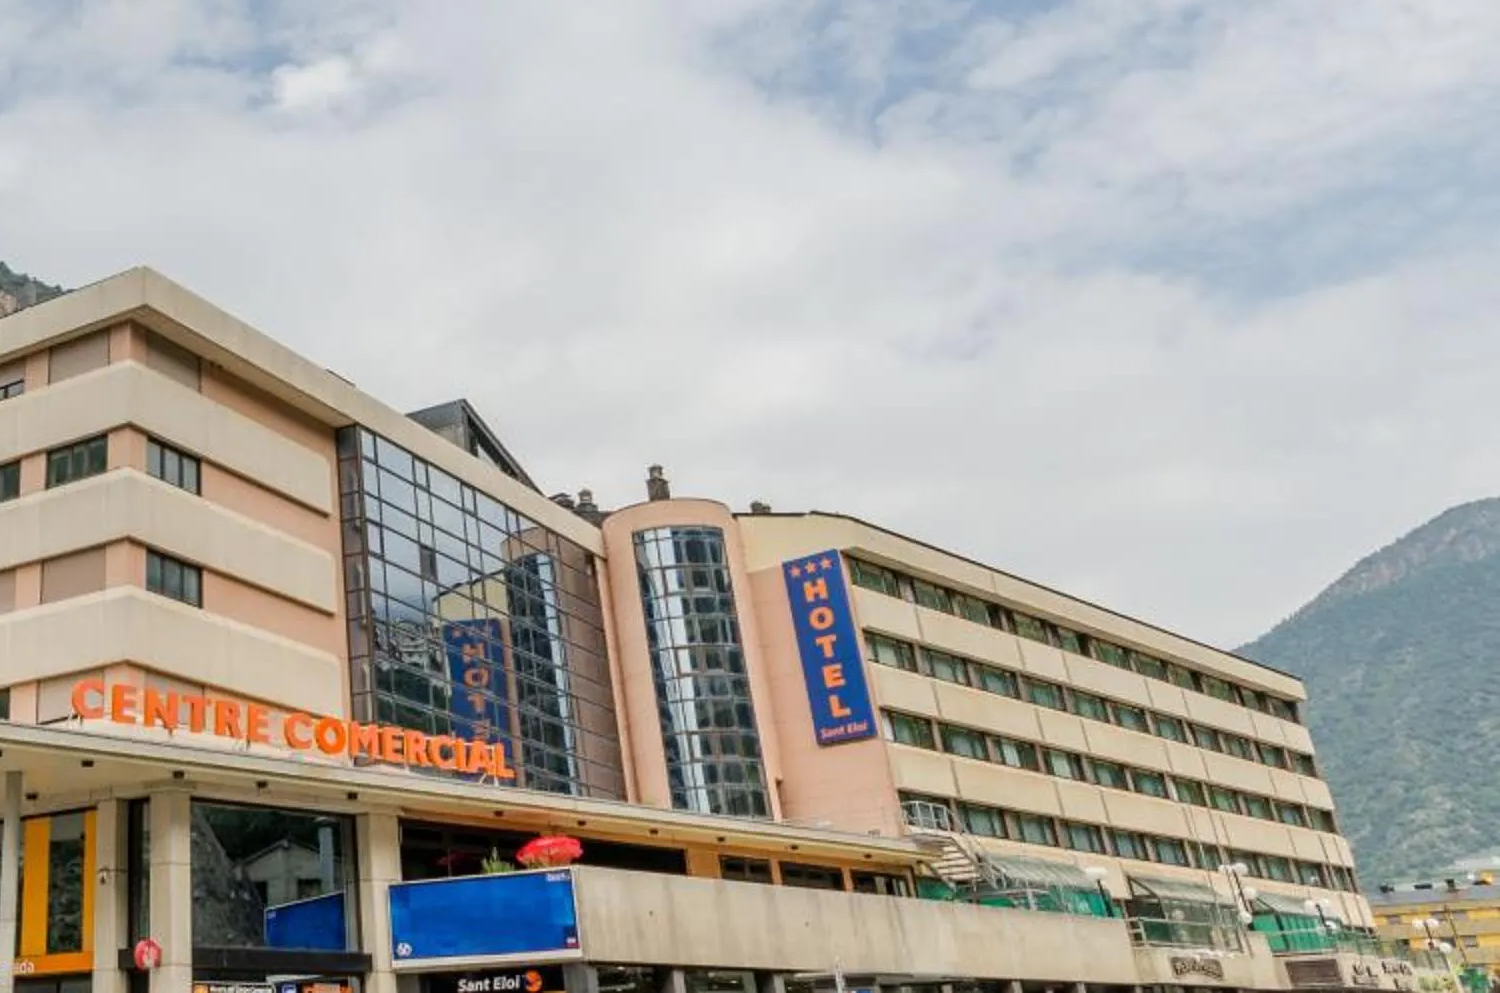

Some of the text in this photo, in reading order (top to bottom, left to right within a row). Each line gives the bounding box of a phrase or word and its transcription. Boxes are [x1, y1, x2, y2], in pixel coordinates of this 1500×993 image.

[803, 578, 851, 718] HOTEL
[71, 678, 516, 780] CENTRE COMERCIAL
[820, 725, 845, 739] Sant
[457, 974, 520, 992] Sant Eloi
